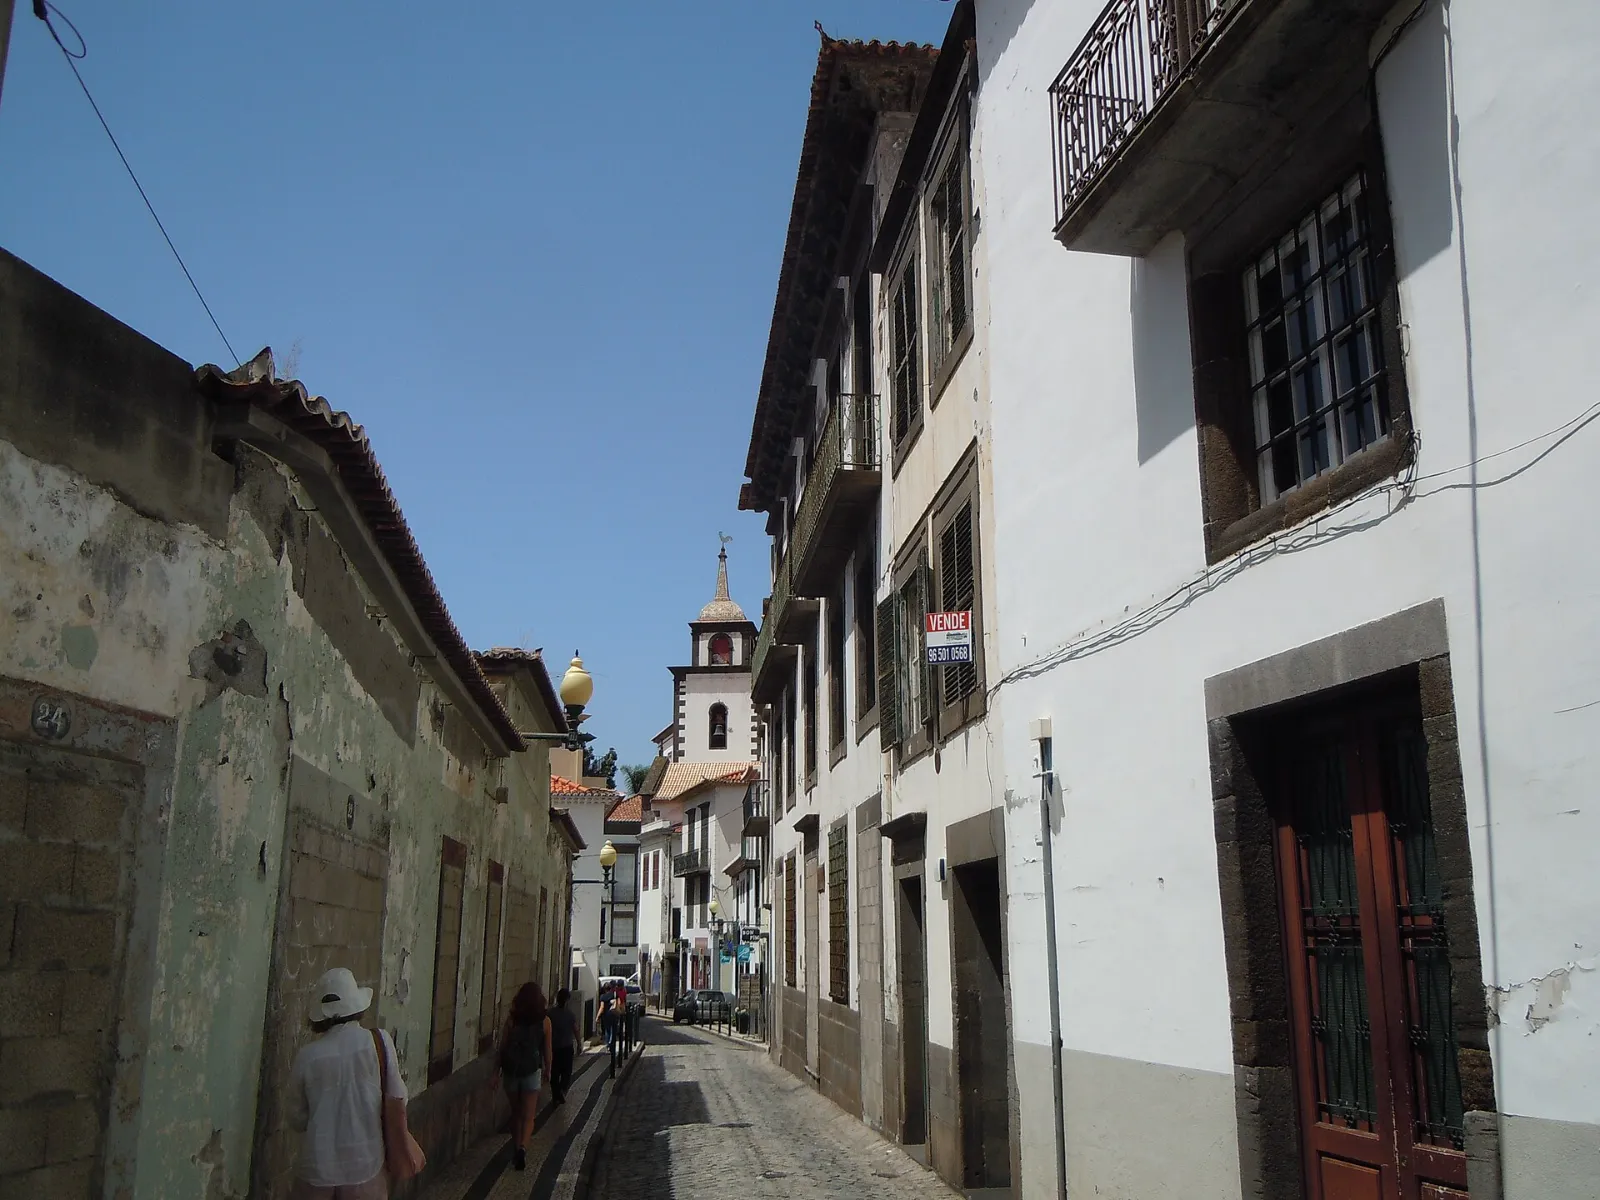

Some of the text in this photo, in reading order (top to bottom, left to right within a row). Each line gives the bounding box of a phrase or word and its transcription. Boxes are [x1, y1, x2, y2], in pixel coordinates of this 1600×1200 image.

[929, 612, 966, 631] VENDE
[928, 646, 968, 662] 96 501 0568
[36, 702, 63, 732] 24
